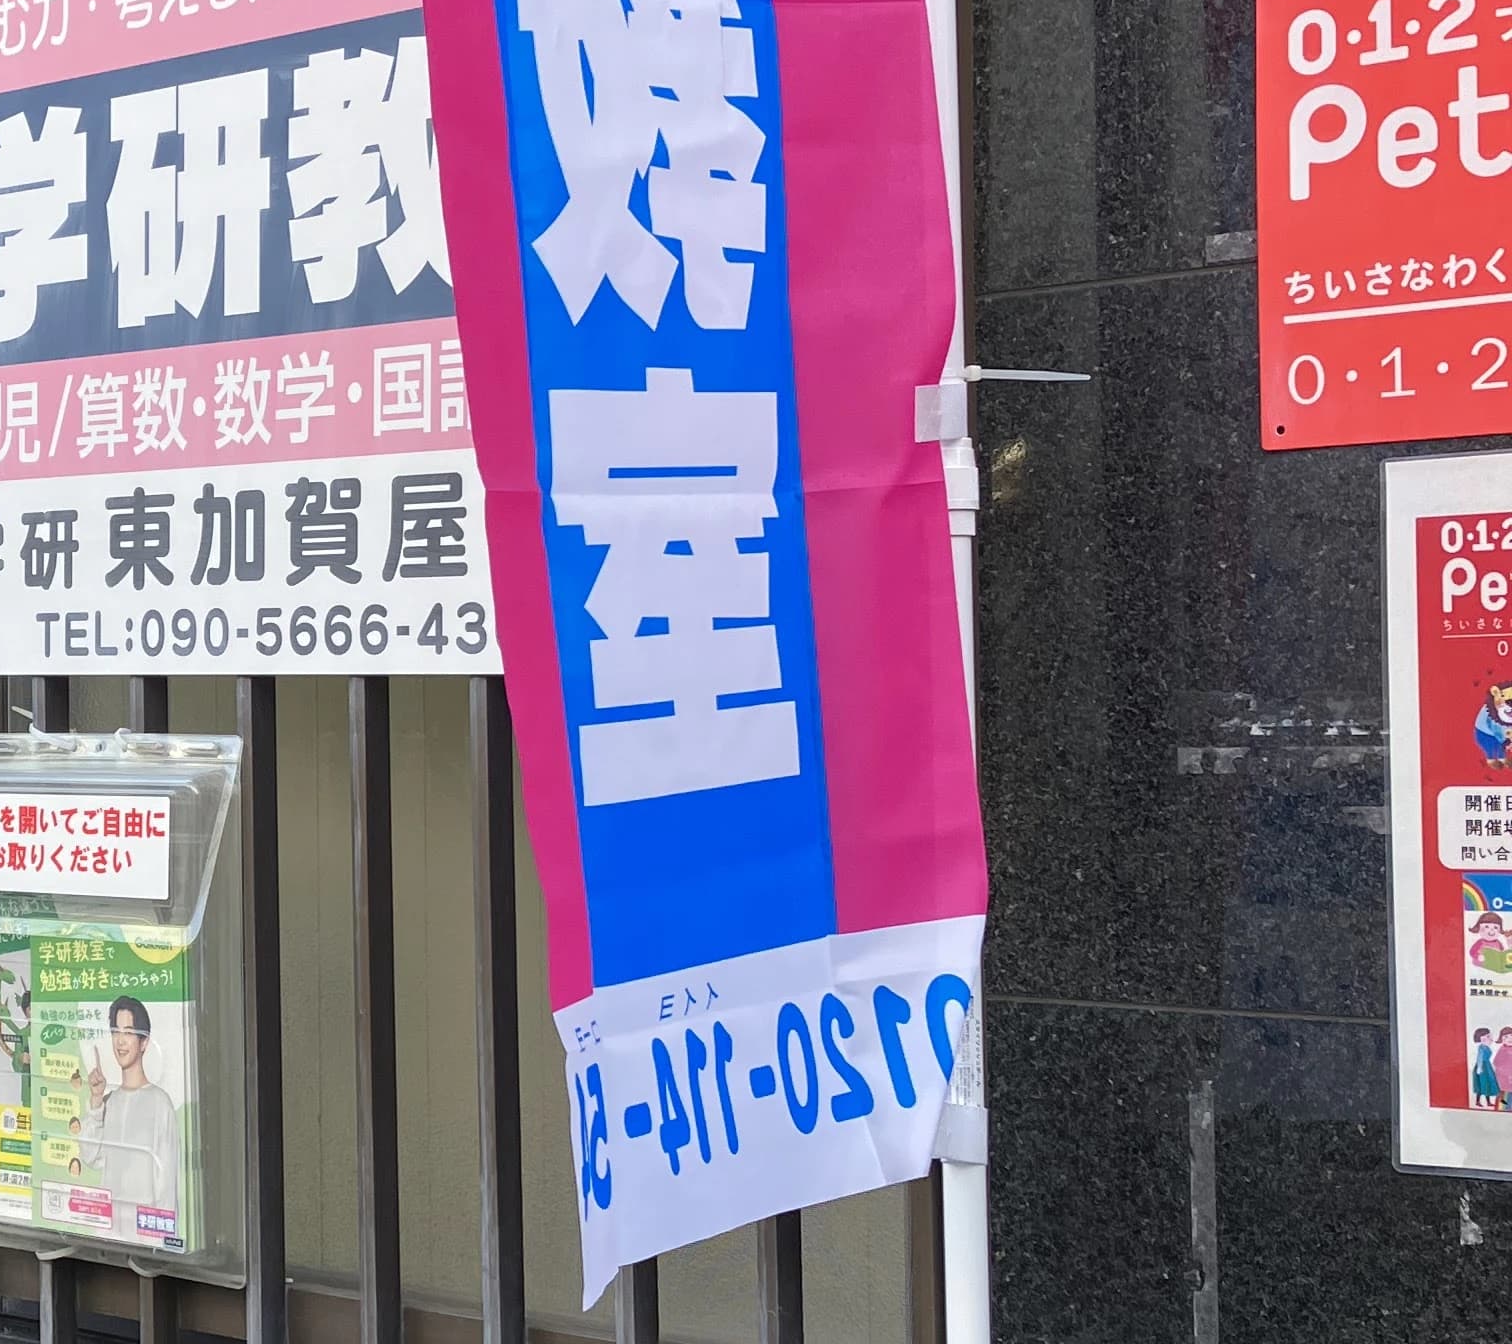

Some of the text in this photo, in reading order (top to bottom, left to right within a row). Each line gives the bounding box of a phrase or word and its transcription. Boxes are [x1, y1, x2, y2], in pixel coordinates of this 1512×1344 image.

[1289, 65, 1512, 202] Pet
[1284, 248, 1507, 305] ちいさなわく
[1442, 557, 1512, 613] Pe
[1442, 617, 1512, 632] ちいさな
[38, 940, 116, 965] 学研教室で
